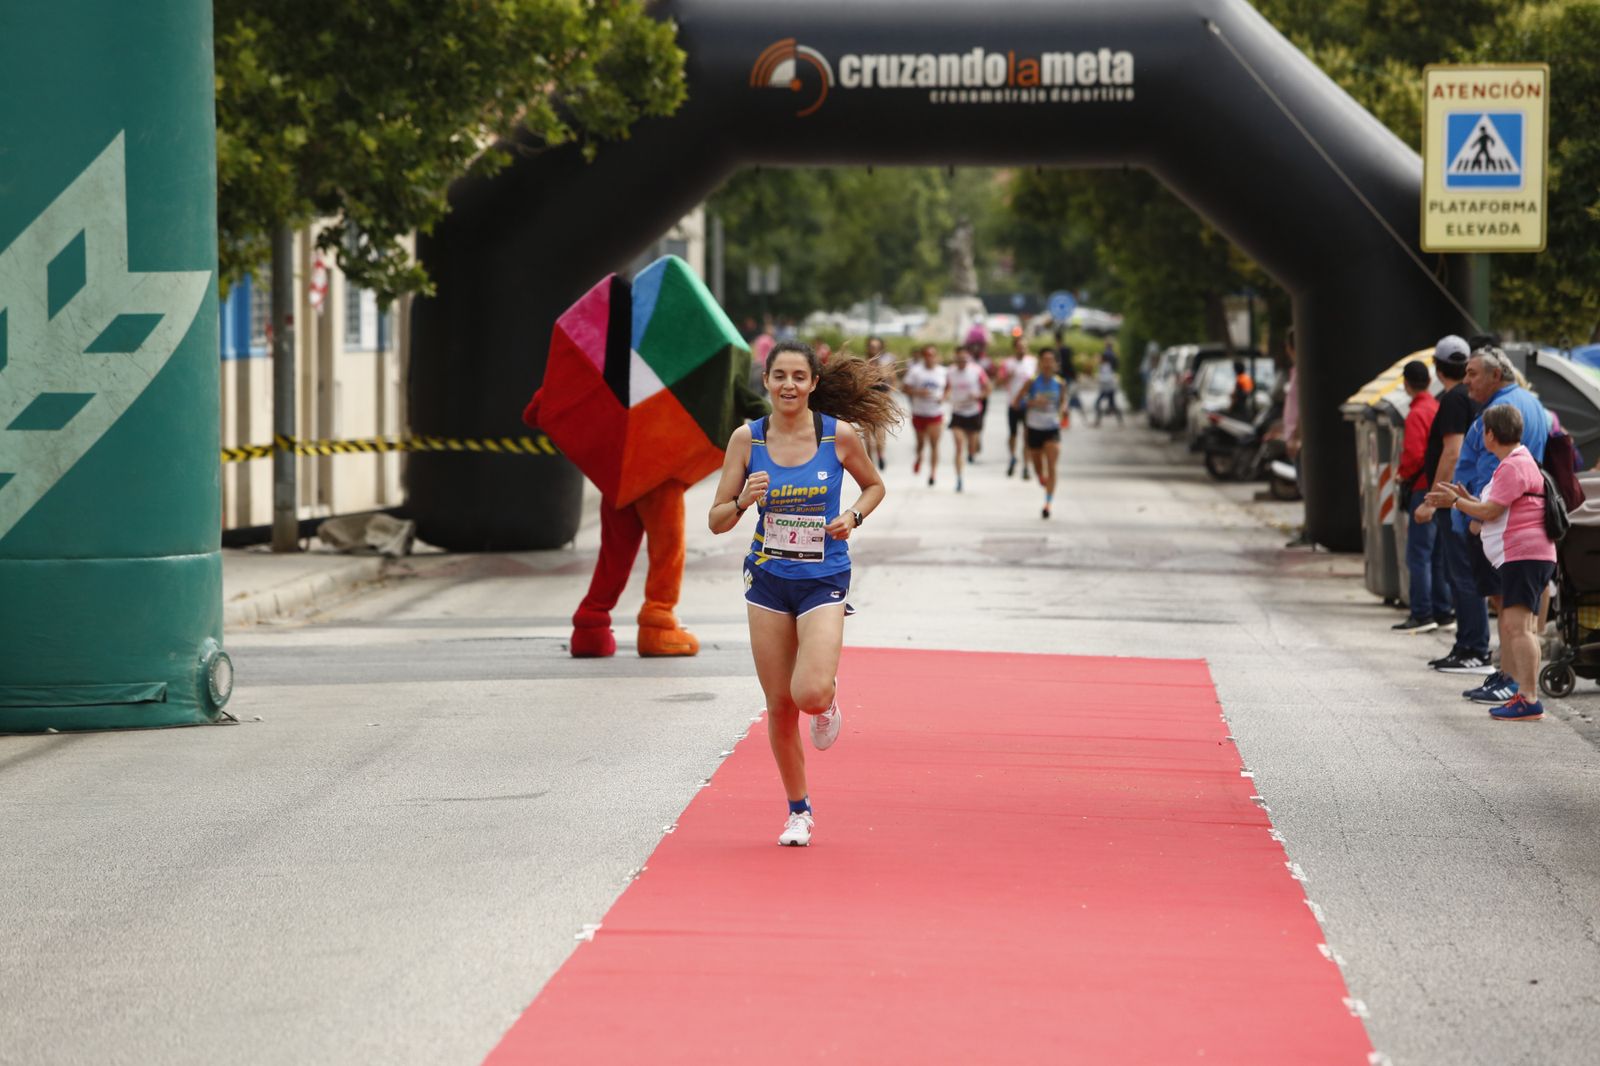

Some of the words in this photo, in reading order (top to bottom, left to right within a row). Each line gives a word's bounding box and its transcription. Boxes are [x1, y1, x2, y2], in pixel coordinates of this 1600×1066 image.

[839, 48, 1134, 88] cruzandolameta
[1051, 86, 1135, 103] deportivo
[1432, 80, 1541, 99] ATENCIÓN
[1429, 201, 1538, 214] PLATAFORMA
[1446, 221, 1521, 236] ELEVADA
[770, 485, 827, 498] olimpo
[776, 519, 823, 528] COVIRAN
[789, 531, 797, 544] 2
